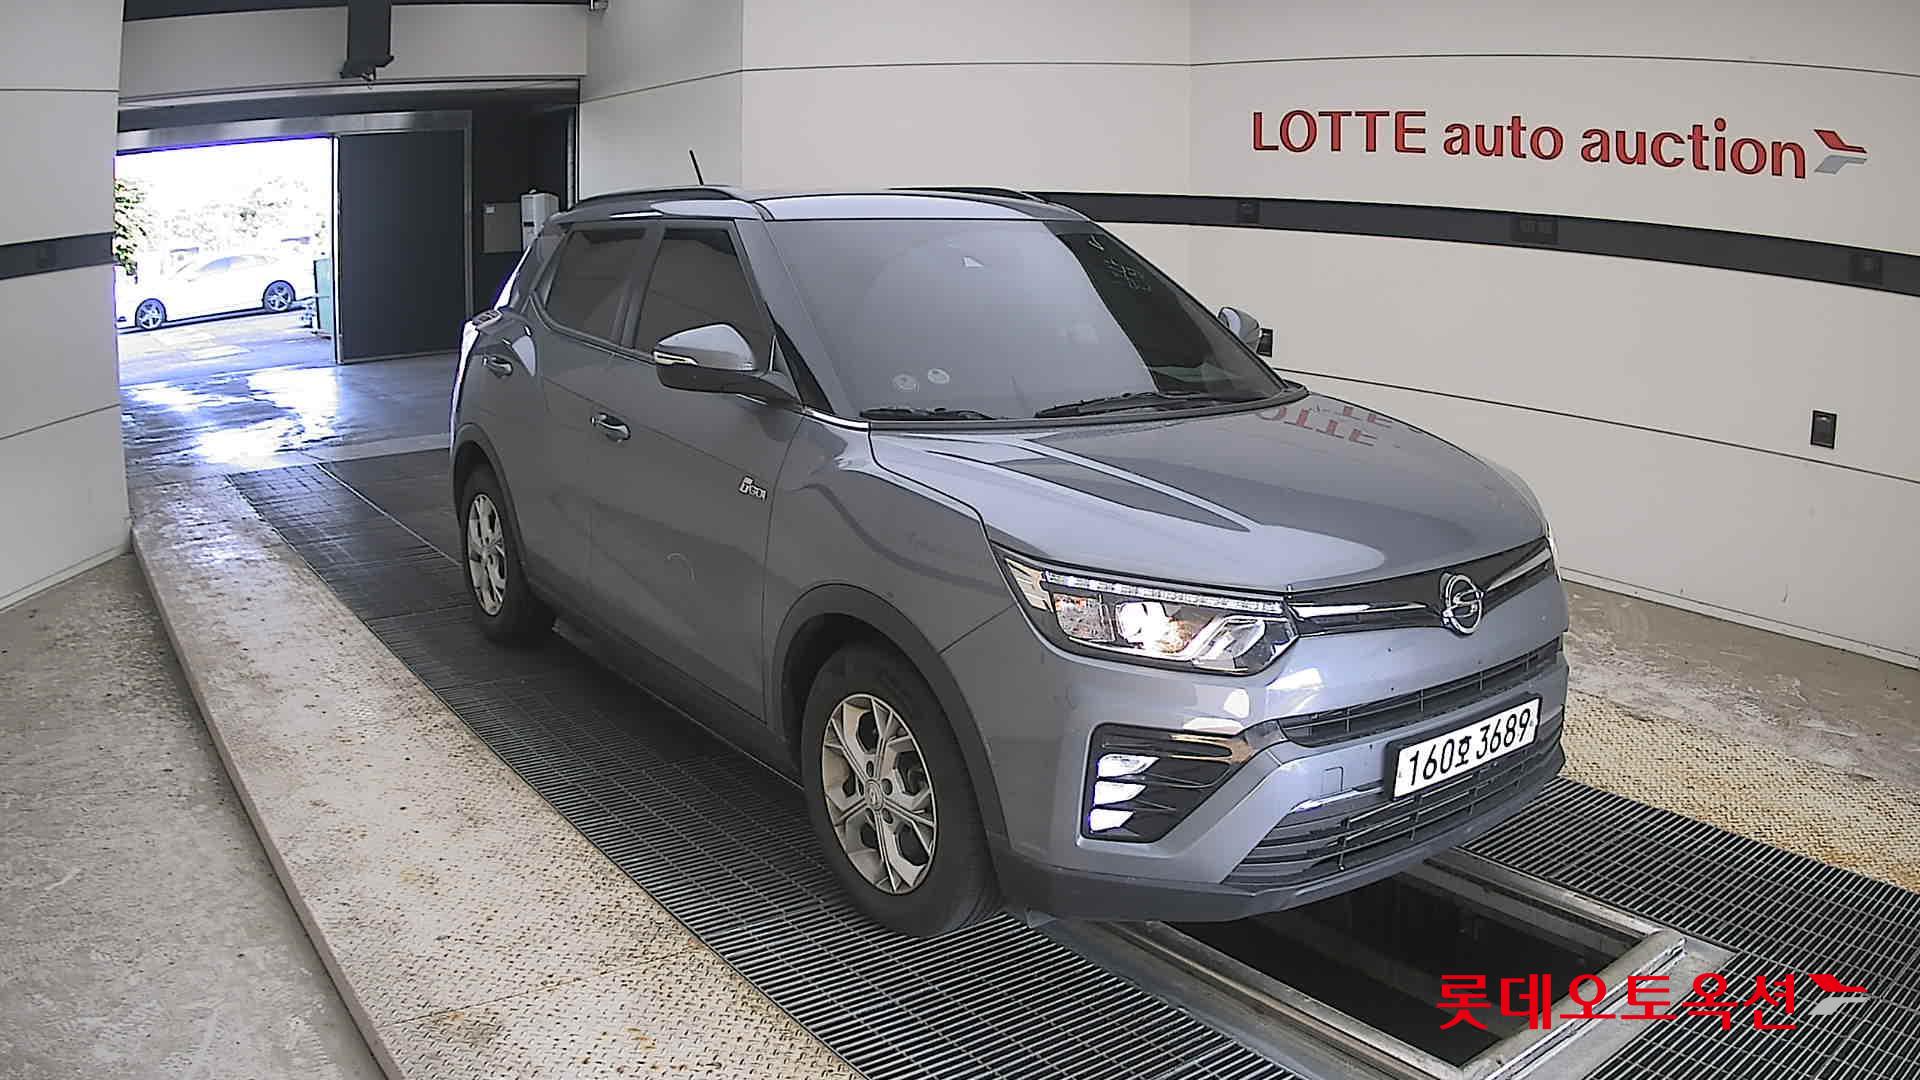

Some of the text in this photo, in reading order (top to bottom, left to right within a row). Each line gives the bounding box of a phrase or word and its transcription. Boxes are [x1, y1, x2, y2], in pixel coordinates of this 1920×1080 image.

[1252, 110, 1807, 179] LOTTE auto auction
